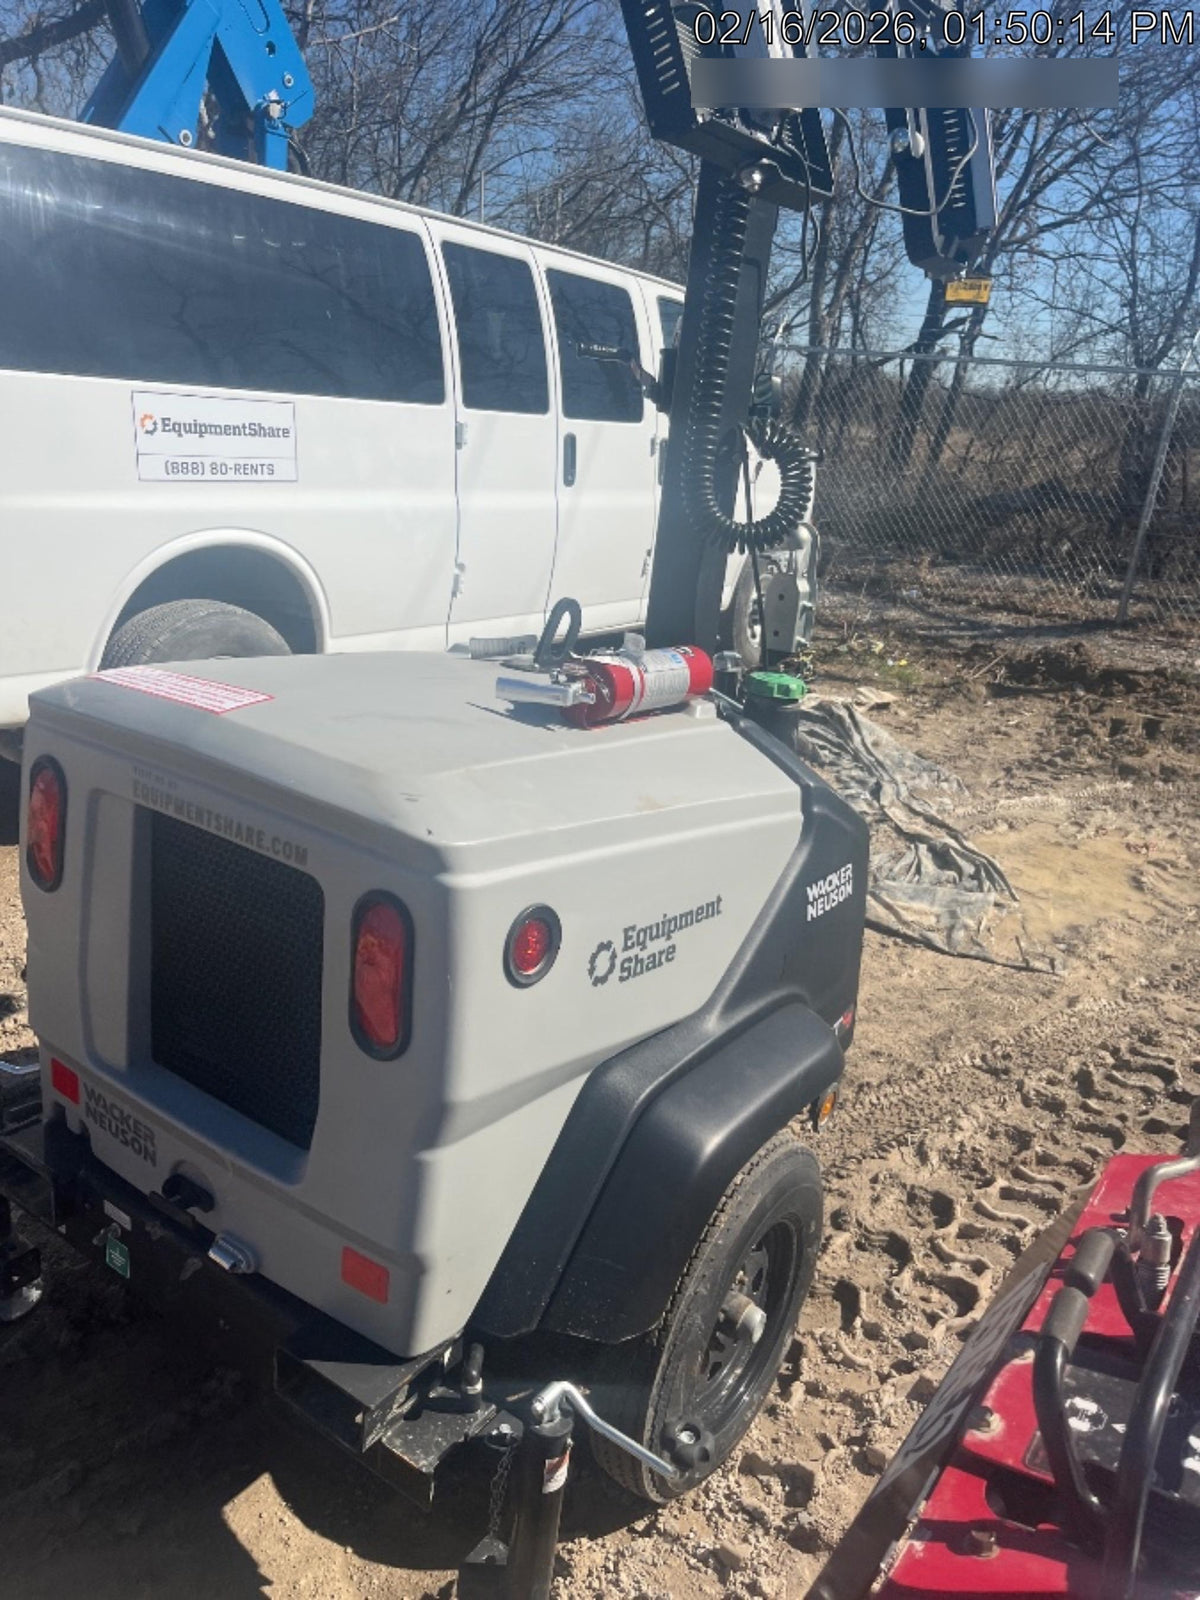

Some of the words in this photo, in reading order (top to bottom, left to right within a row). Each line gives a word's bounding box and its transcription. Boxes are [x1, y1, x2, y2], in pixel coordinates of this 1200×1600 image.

[160, 417, 291, 438] EquipmentShare
[164, 460, 205, 476] (888)
[210, 462, 275, 476] 80-RENTS
[133, 778, 308, 866] EQUIPMENTSHARE.COM
[806, 863, 853, 902] WACKER
[807, 879, 853, 921] NEUSON
[621, 894, 722, 952] Equipment
[618, 943, 676, 982] Share
[83, 1082, 156, 1148] WACKER
[85, 1101, 157, 1167] NEUSON
